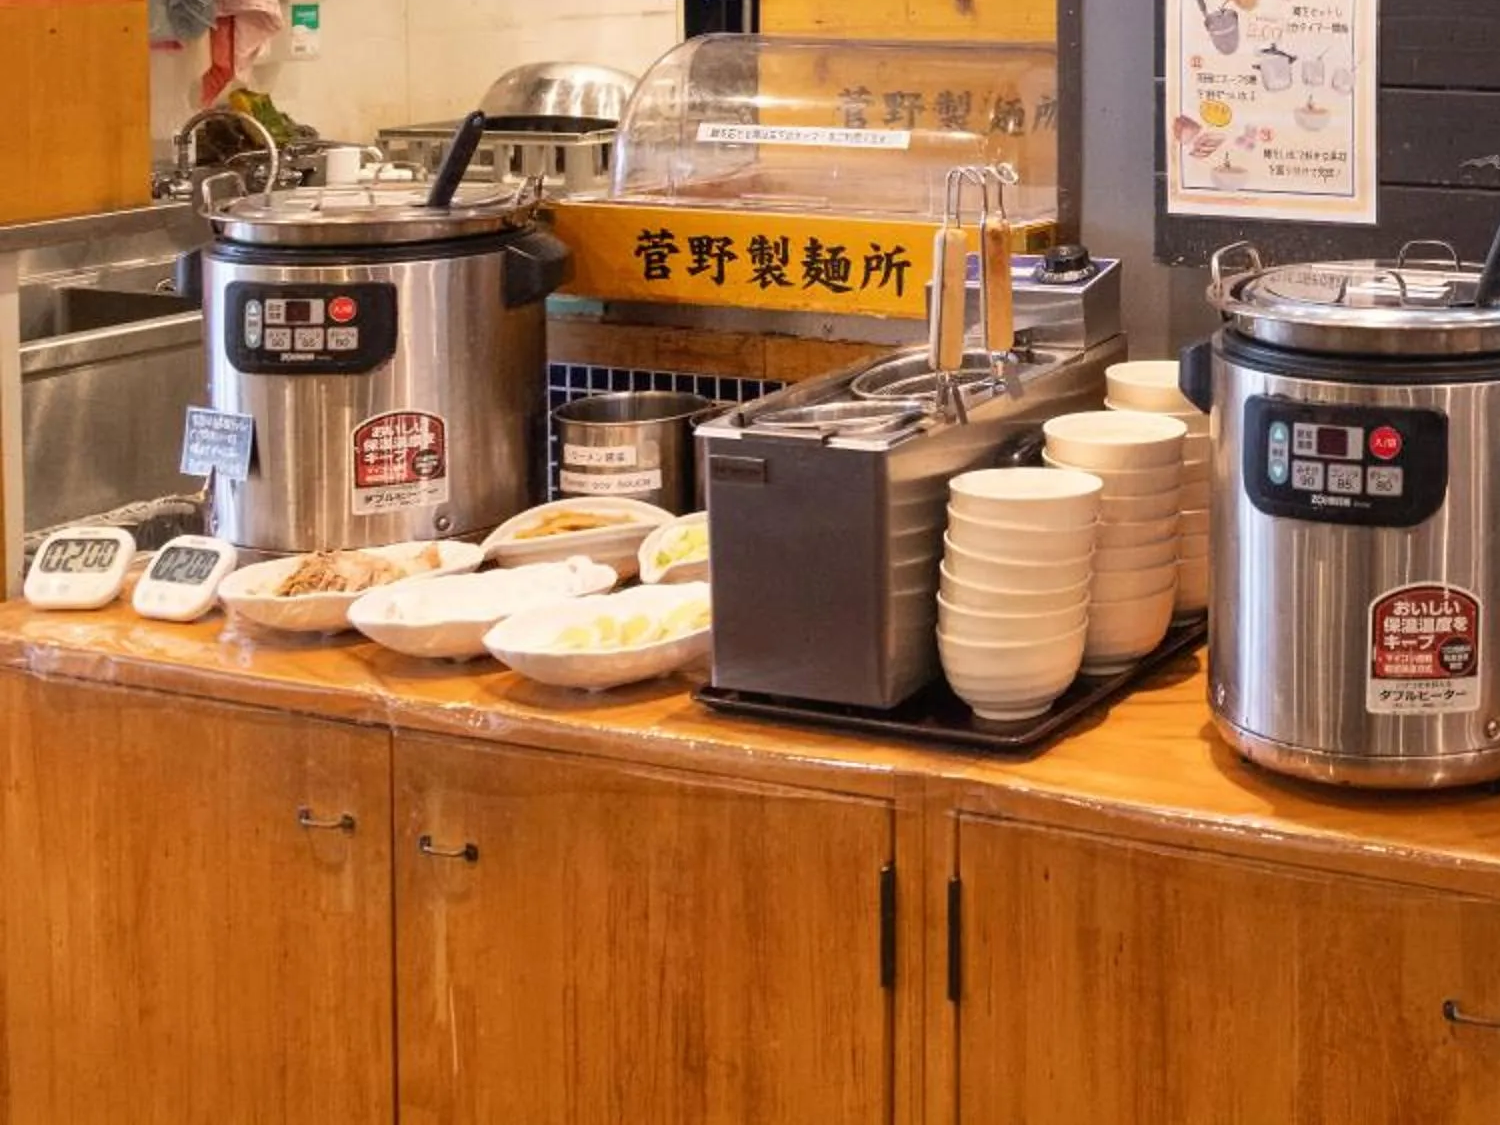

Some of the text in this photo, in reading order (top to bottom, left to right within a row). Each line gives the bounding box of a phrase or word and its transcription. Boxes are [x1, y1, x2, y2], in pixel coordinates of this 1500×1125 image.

[634, 227, 912, 297] 菅野製麺所
[1393, 599, 1462, 616] おいしい
[1383, 633, 1435, 651] キープ
